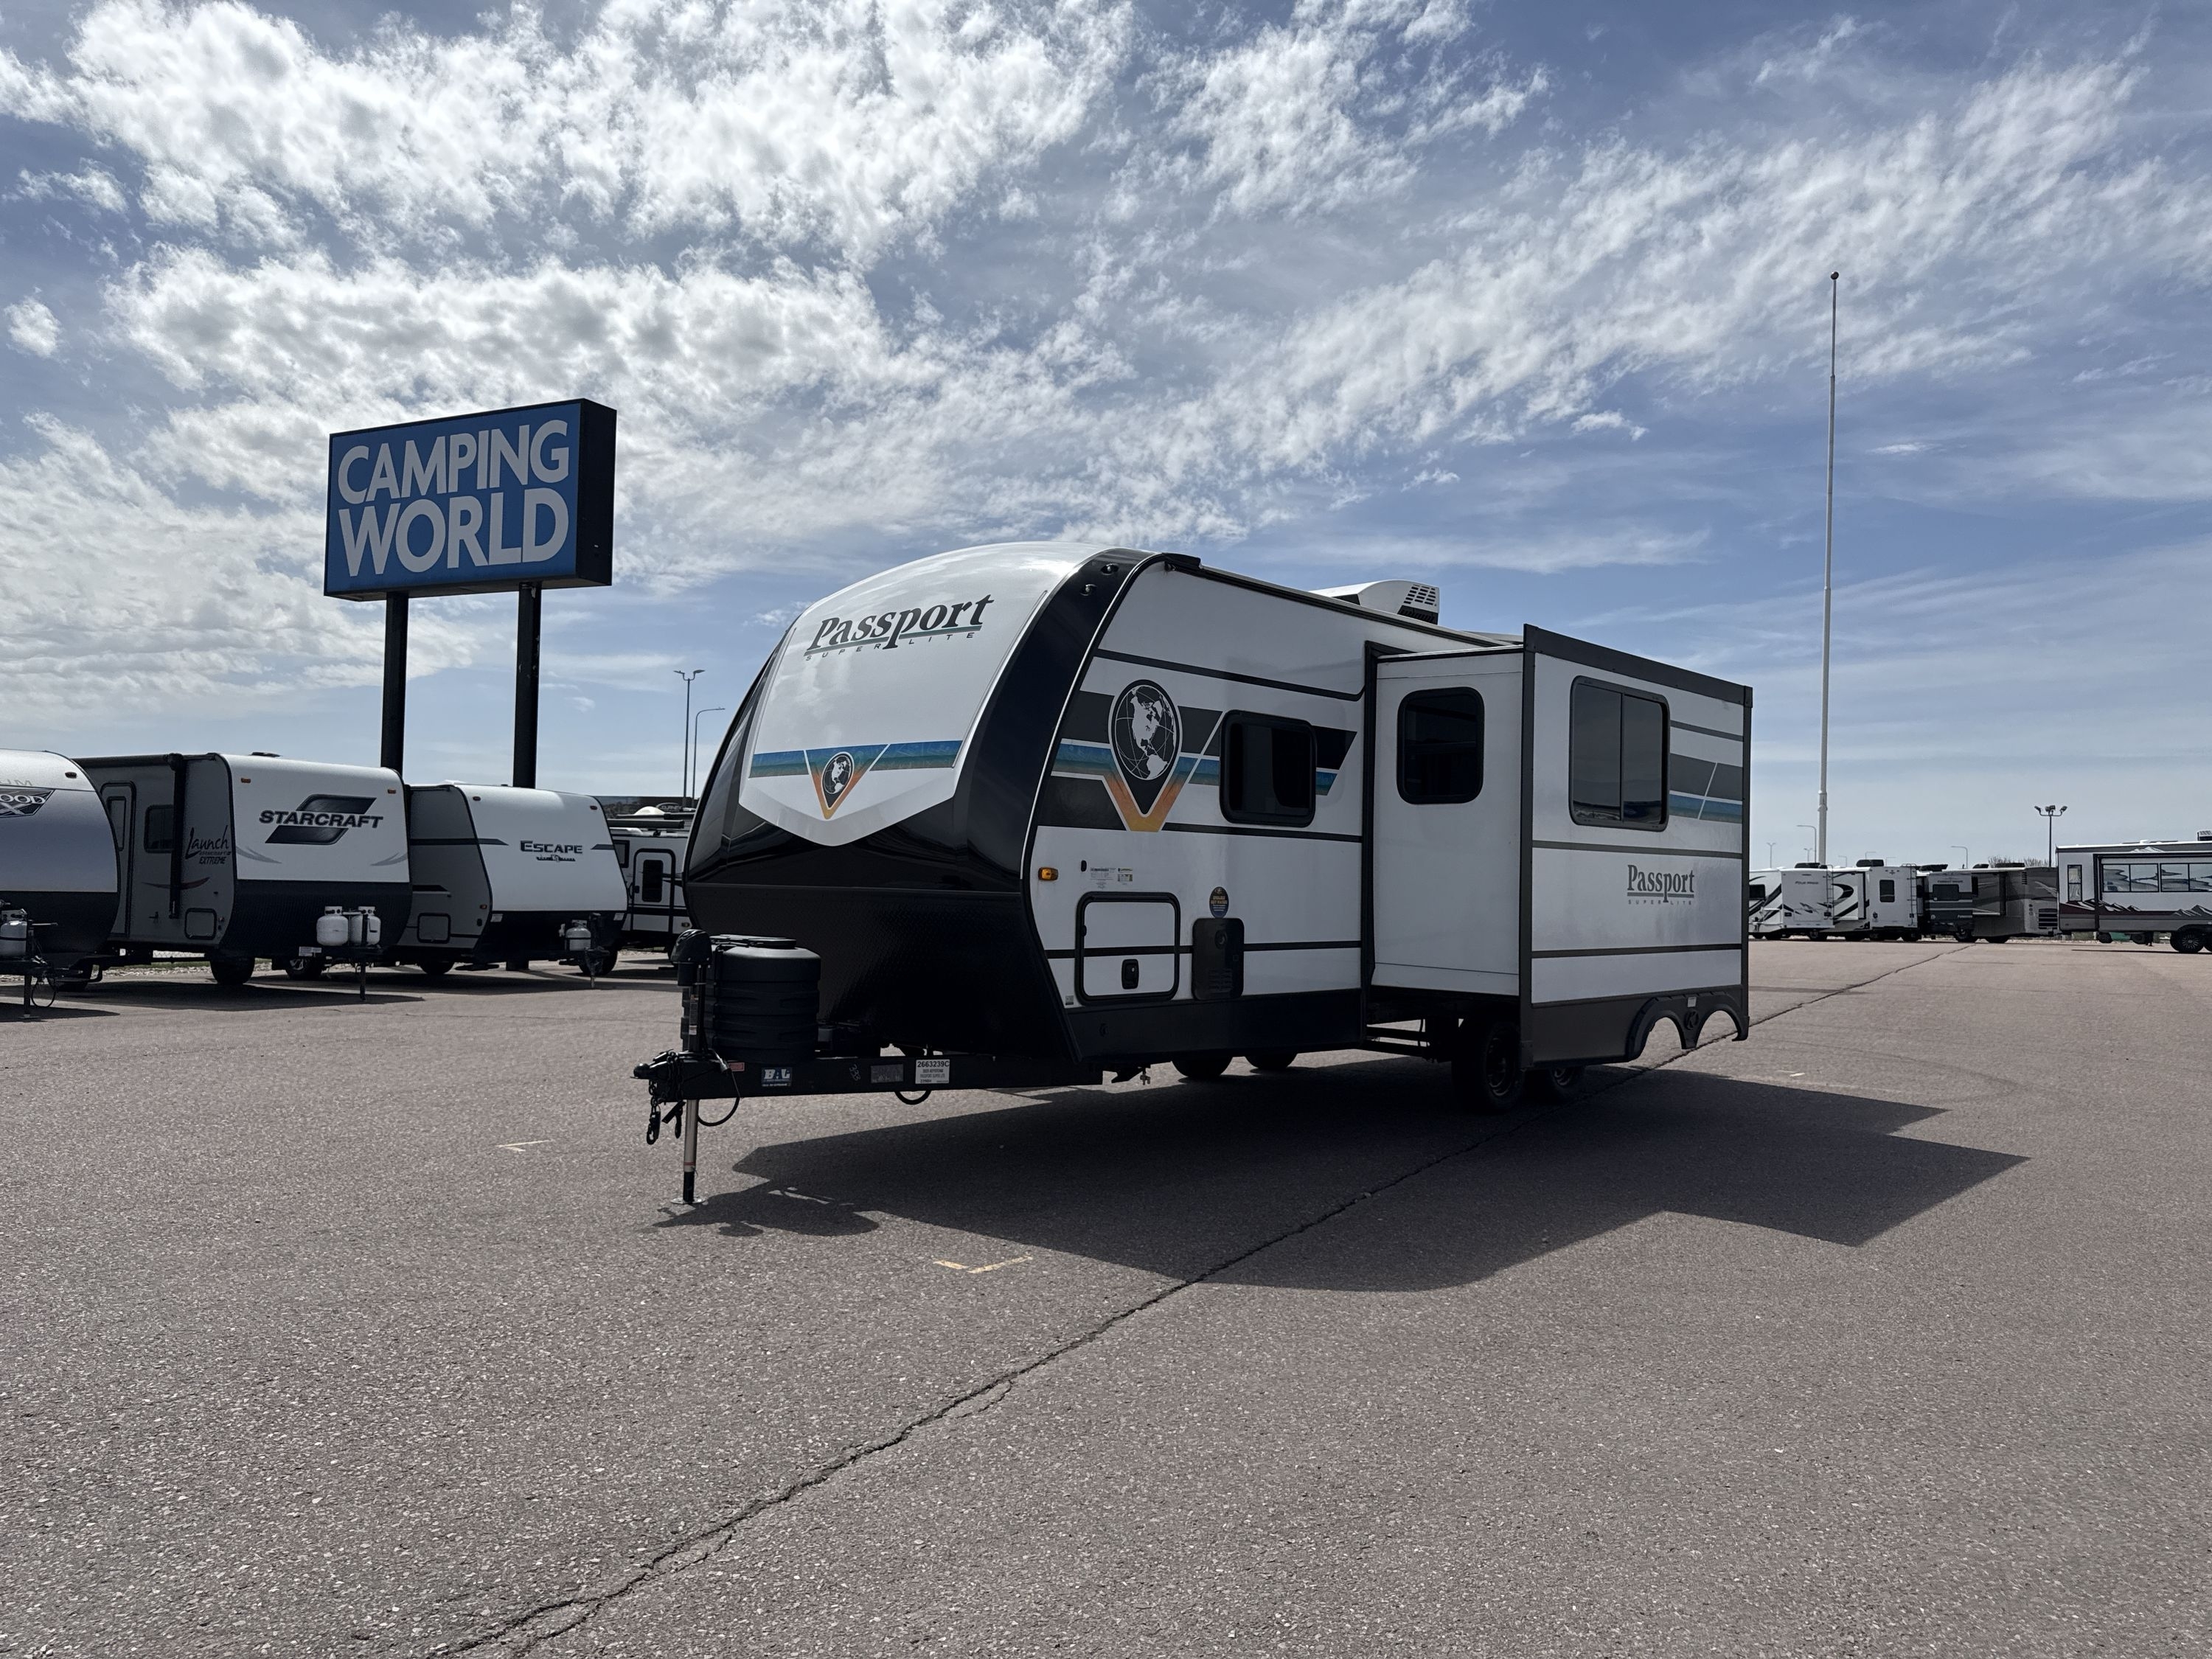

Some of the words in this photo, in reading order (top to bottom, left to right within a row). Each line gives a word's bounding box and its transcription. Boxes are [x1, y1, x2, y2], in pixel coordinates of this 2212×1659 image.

[338, 420, 569, 504] CAMPING
[338, 487, 568, 577] WORLD
[807, 594, 994, 650] Passport
[806, 643, 881, 661] SUPER
[908, 632, 975, 645] LITE
[259, 810, 383, 829] STARCRAFT
[185, 825, 229, 860] Launch
[199, 856, 226, 865] EXTREME
[1627, 865, 1694, 902] Passport
